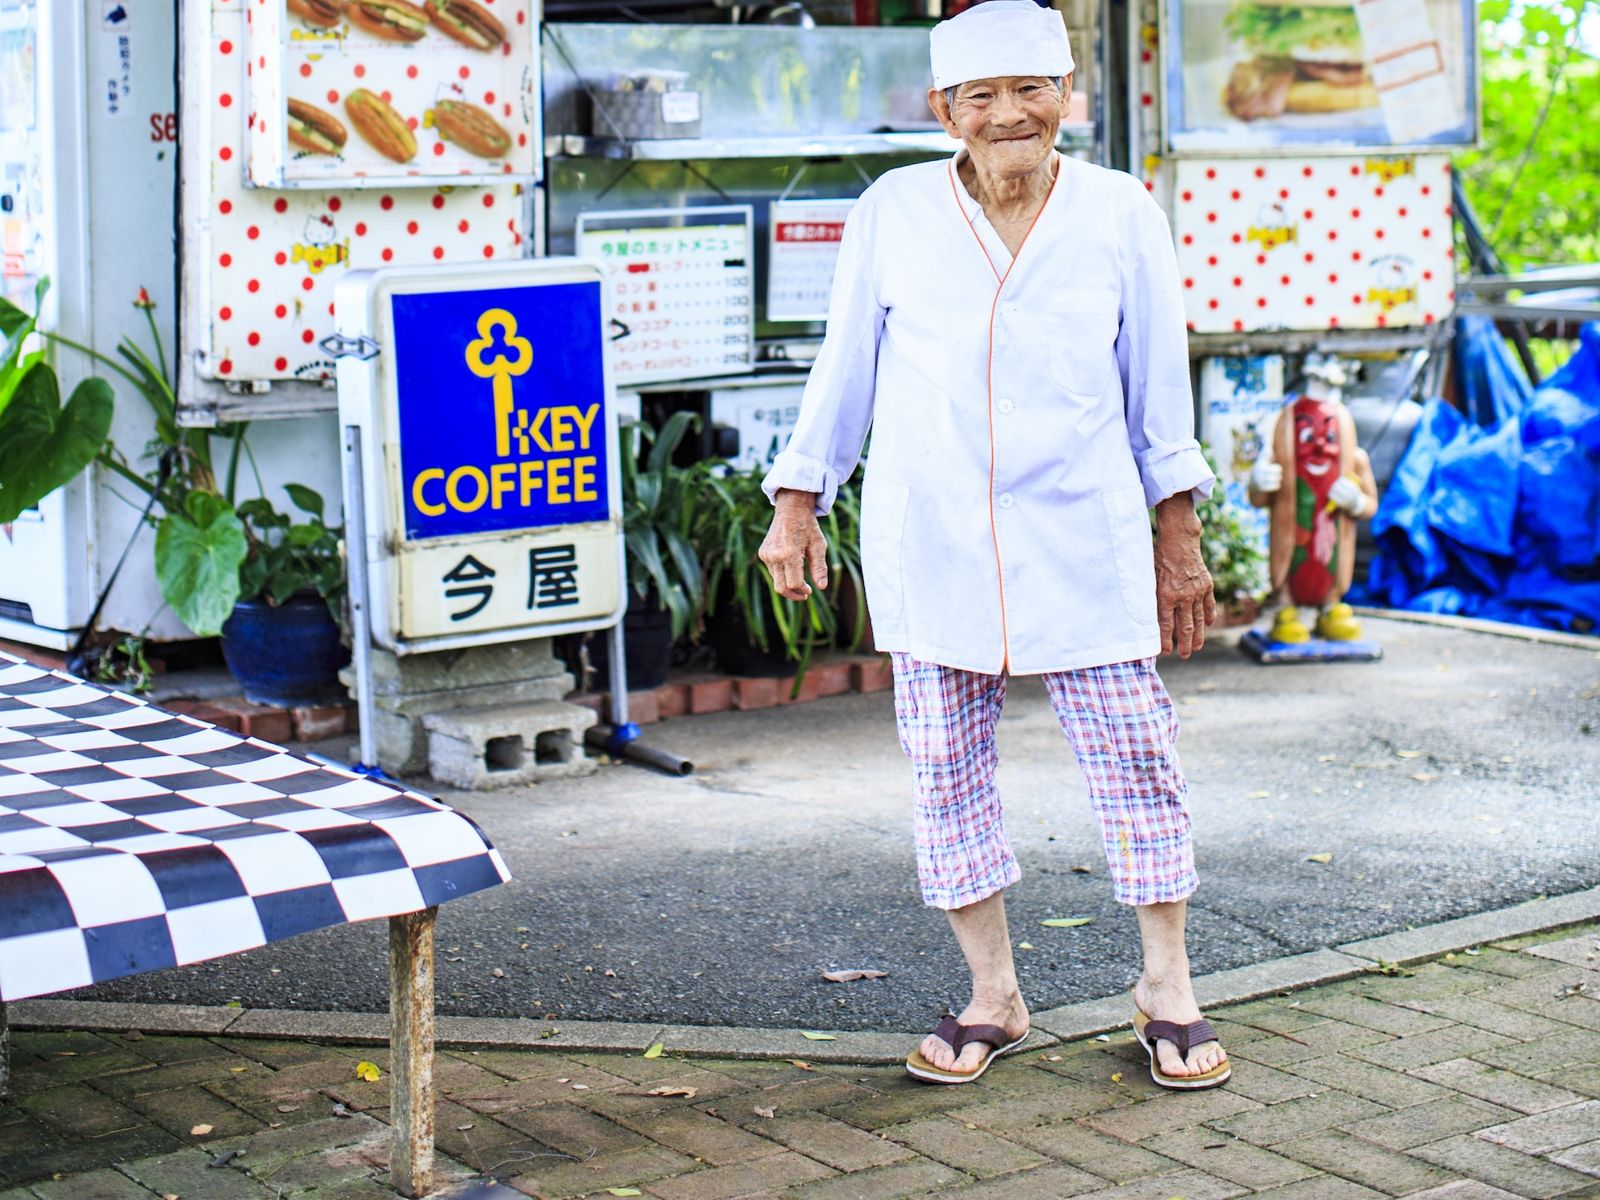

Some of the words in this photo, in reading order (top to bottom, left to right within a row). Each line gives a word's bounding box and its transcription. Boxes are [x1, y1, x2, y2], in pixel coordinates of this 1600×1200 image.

[511, 402, 601, 456] KEY
[411, 455, 599, 518] COFFEE
[442, 543, 580, 622] 今屋
